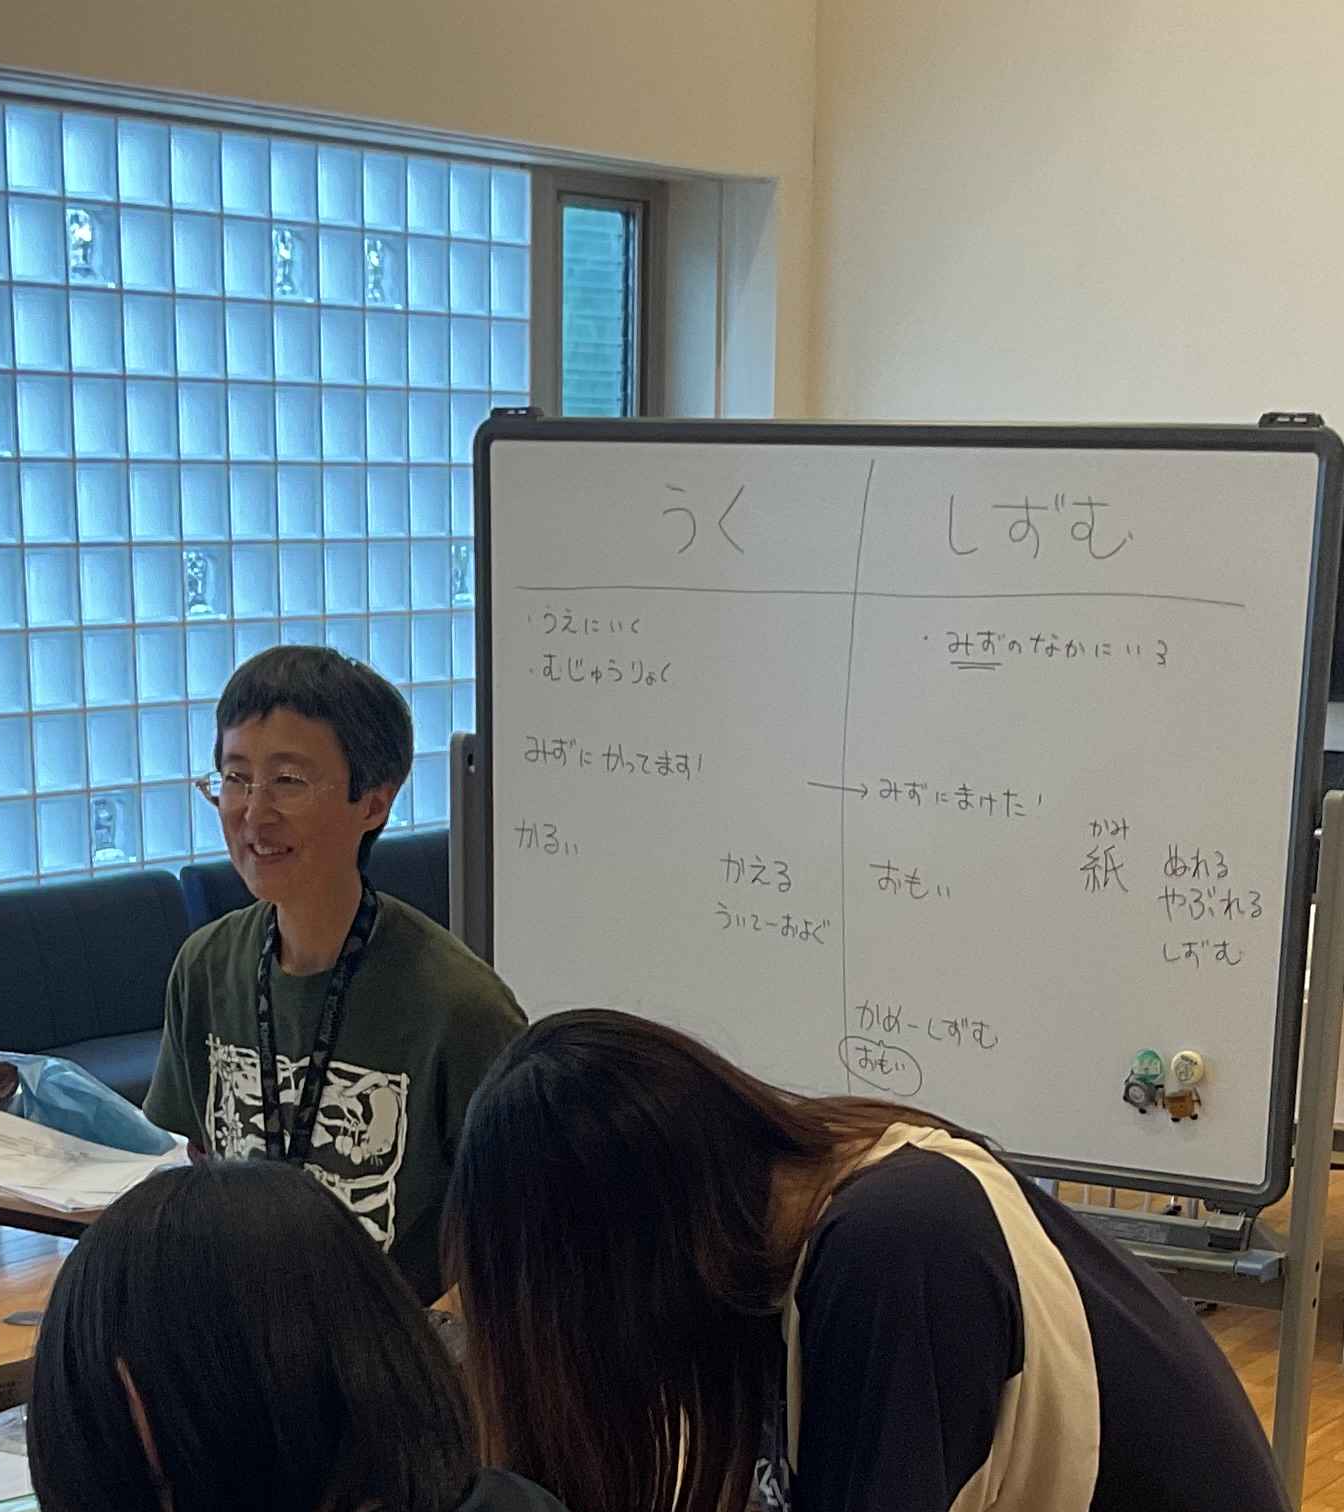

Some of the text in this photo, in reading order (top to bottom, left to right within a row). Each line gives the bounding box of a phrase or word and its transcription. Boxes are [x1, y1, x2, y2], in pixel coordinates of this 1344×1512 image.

[662, 484, 745, 554] うく
[948, 493, 1135, 560] しずむ
[542, 605, 640, 635] うえにいく
[945, 630, 1169, 666] みずのなかにいる
[541, 653, 672, 686] むじゅうりょく
[514, 819, 579, 855] かるい
[1089, 817, 1130, 841] かみ
[719, 852, 792, 893] かえる
[869, 859, 951, 899] おもい
[1079, 844, 1129, 894] 紙
[1163, 843, 1229, 879] ぬれる
[1157, 885, 1263, 922] やぶれる
[1162, 939, 1242, 968] しずむ
[856, 1045, 905, 1075] おもい
